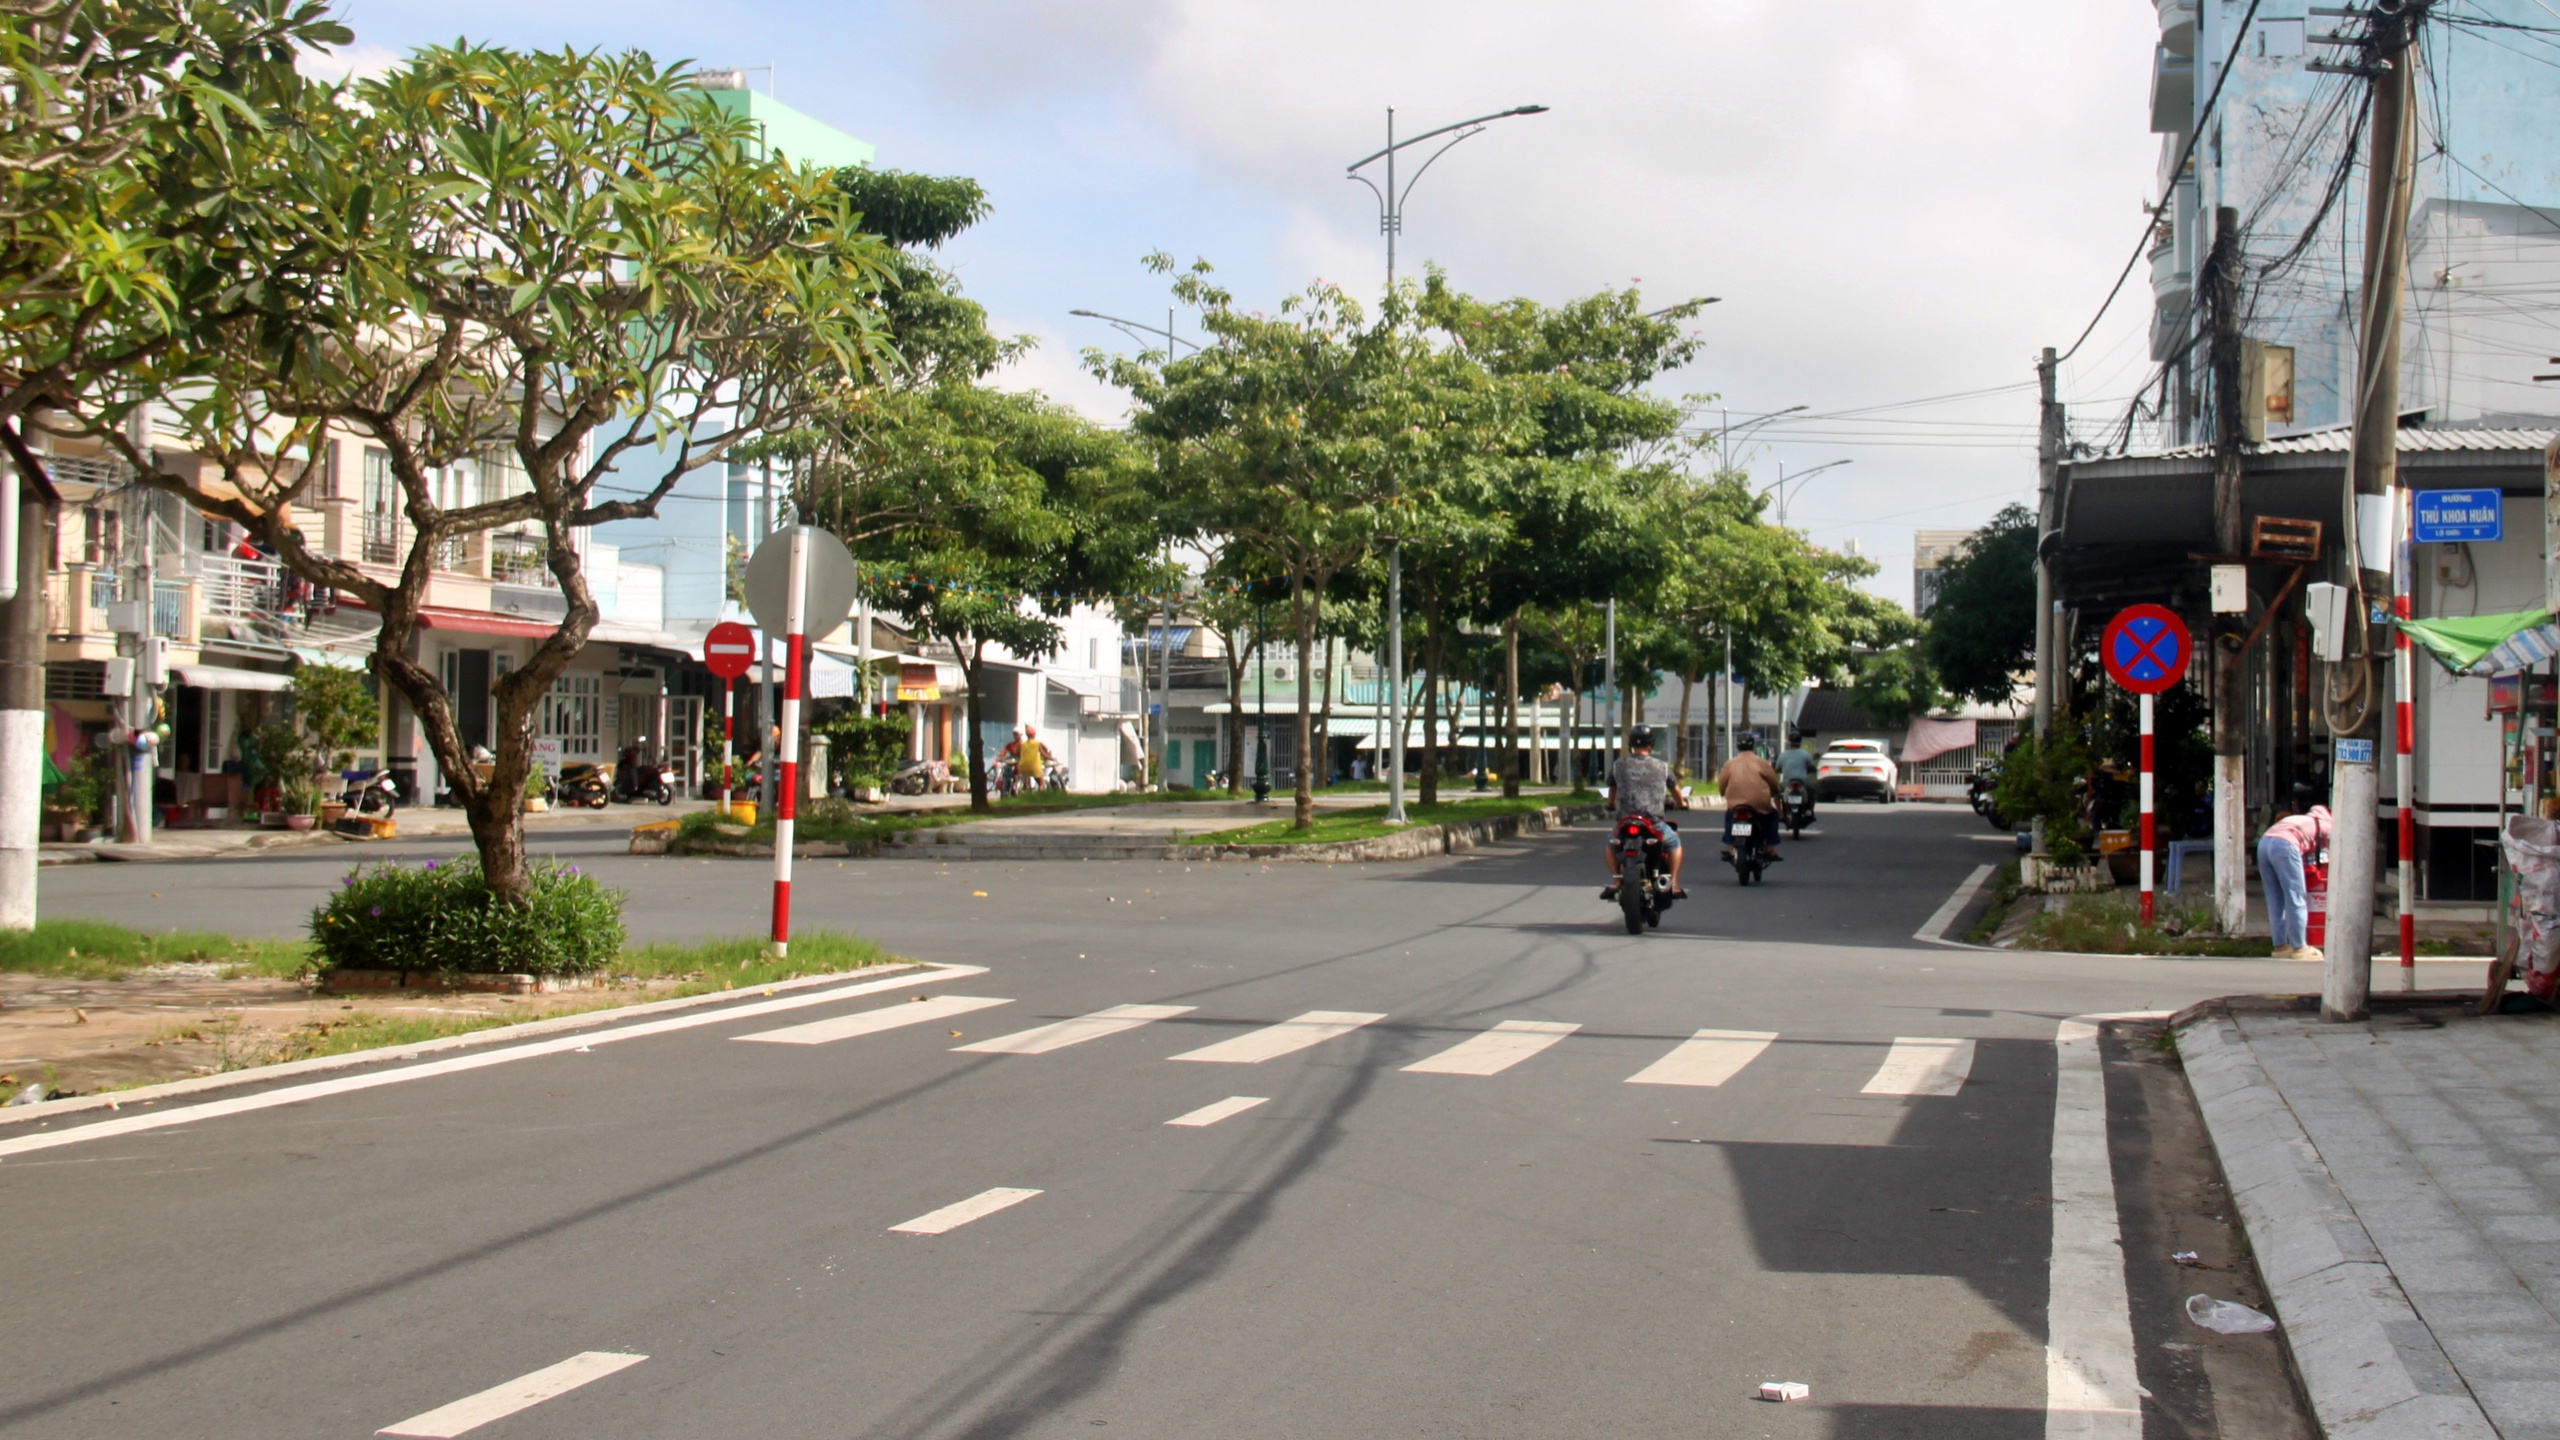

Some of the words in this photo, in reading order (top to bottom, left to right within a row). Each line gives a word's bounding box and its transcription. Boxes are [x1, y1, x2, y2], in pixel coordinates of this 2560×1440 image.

[2442, 494, 2472, 503] ĐƯỜNG
[2420, 505, 2439, 524] THỦ
[2442, 509, 2467, 524] KHOA
[2469, 505, 2495, 523] HUÂN
